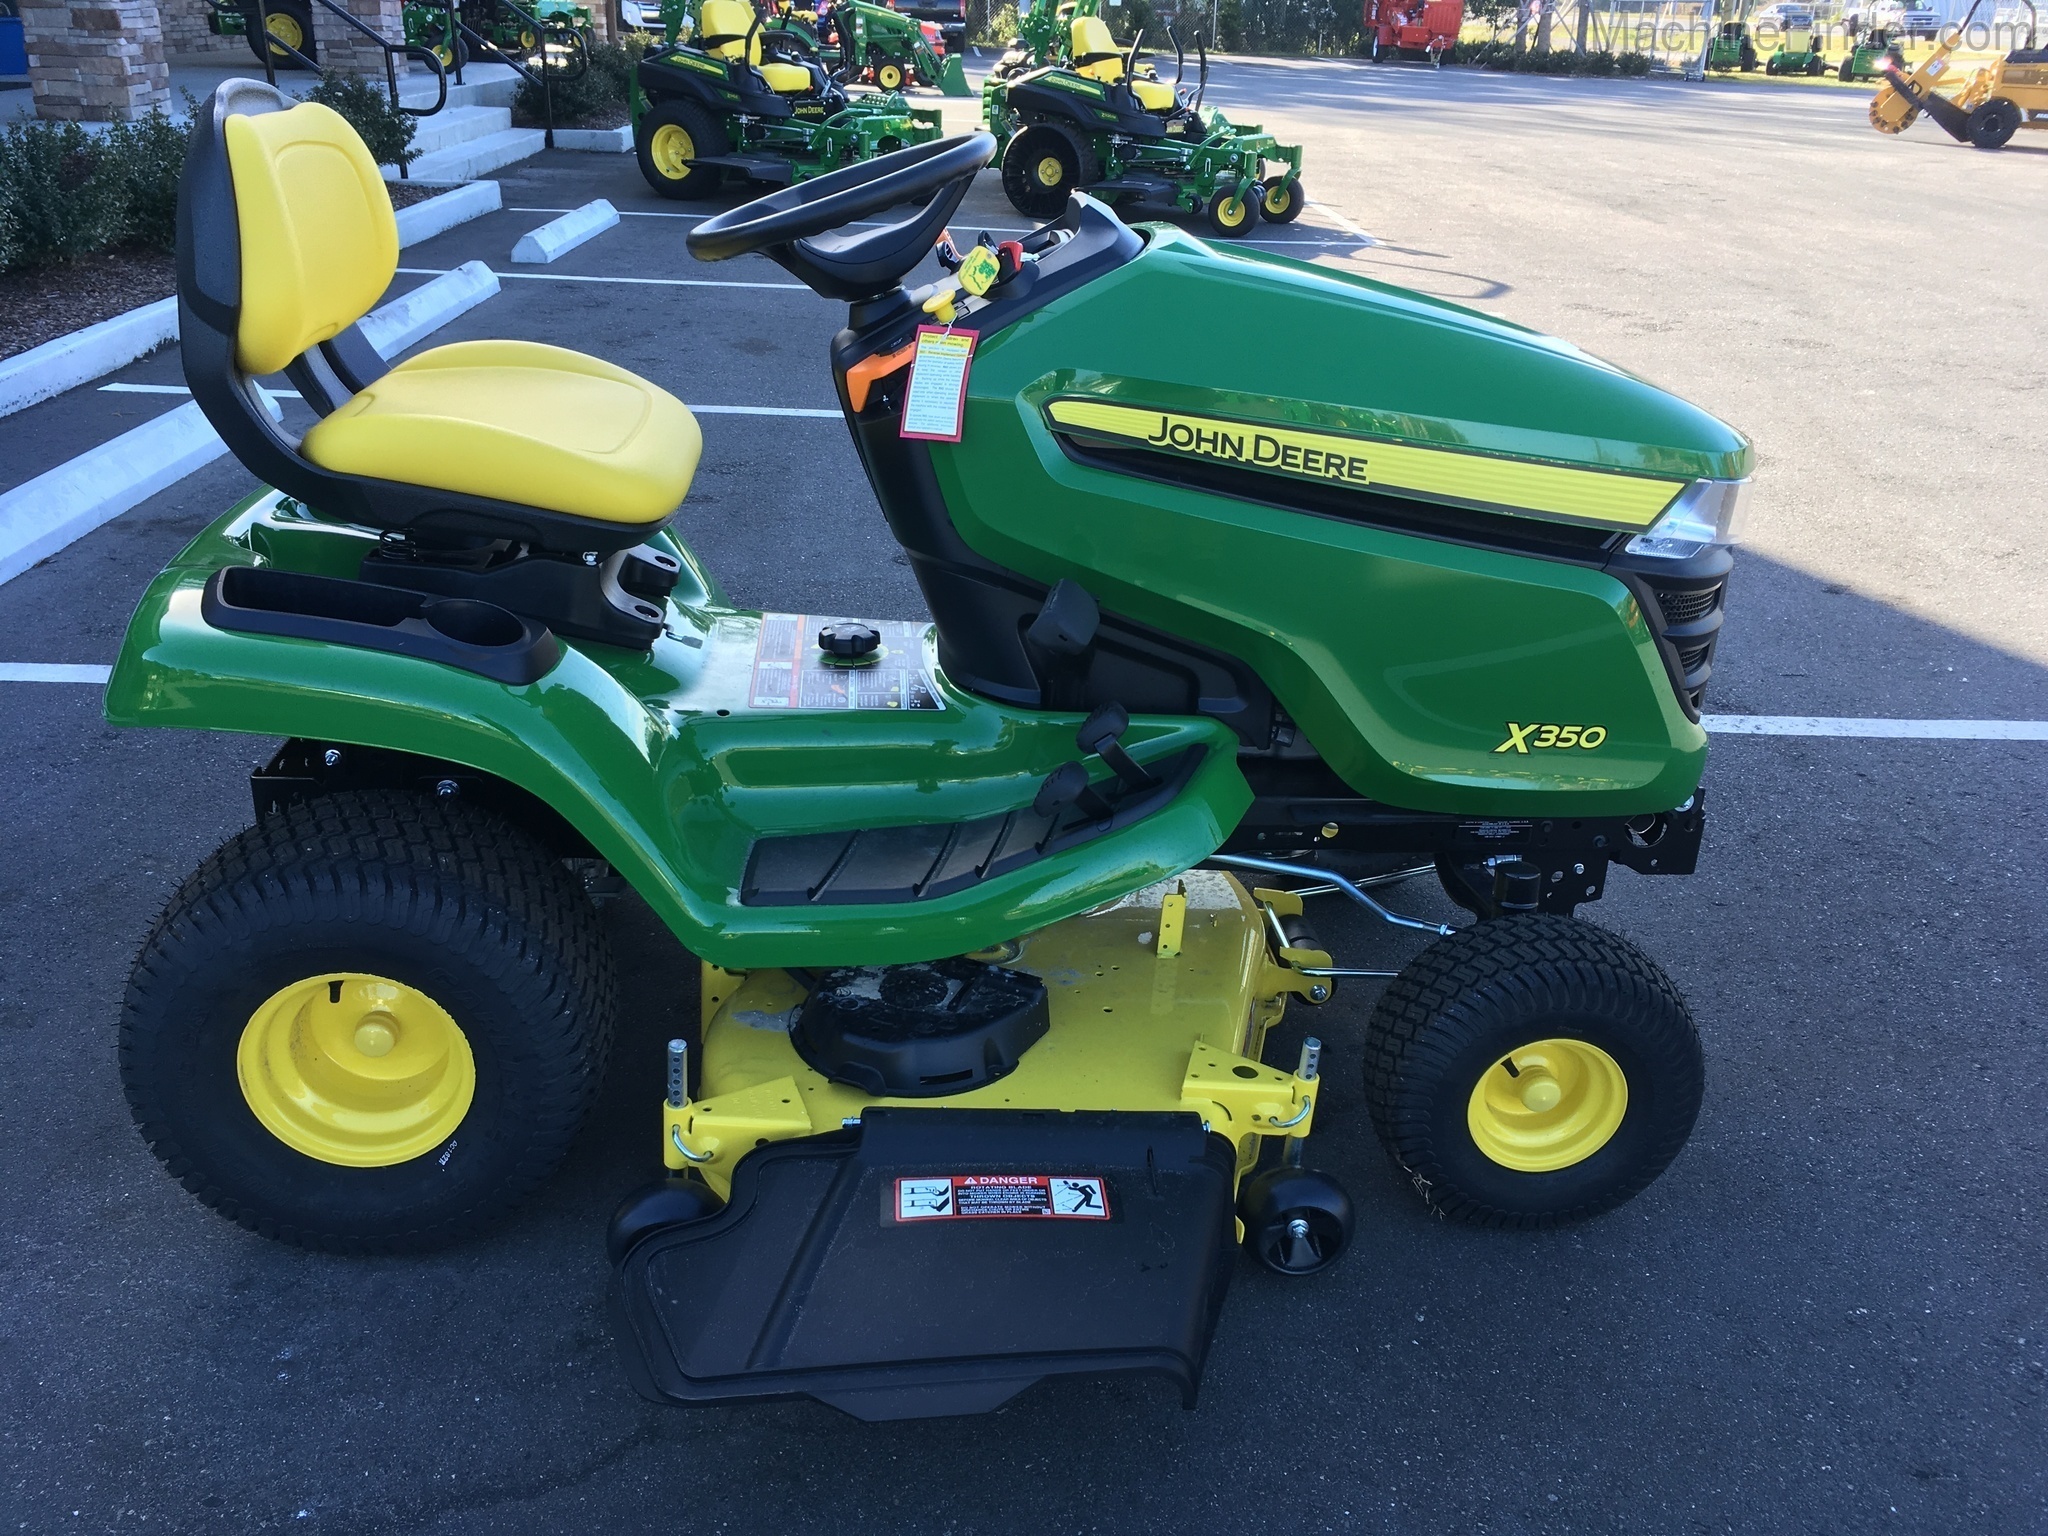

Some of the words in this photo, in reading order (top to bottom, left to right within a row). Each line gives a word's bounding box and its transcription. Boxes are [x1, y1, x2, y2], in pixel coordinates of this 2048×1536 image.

[794, 106, 807, 115] JOHN
[807, 105, 824, 114] DEERE
[1148, 415, 1245, 459] JOHN
[1253, 434, 1369, 482] DEERE
[1491, 721, 1608, 755] X350
[979, 1176, 1038, 1184] DANGER
